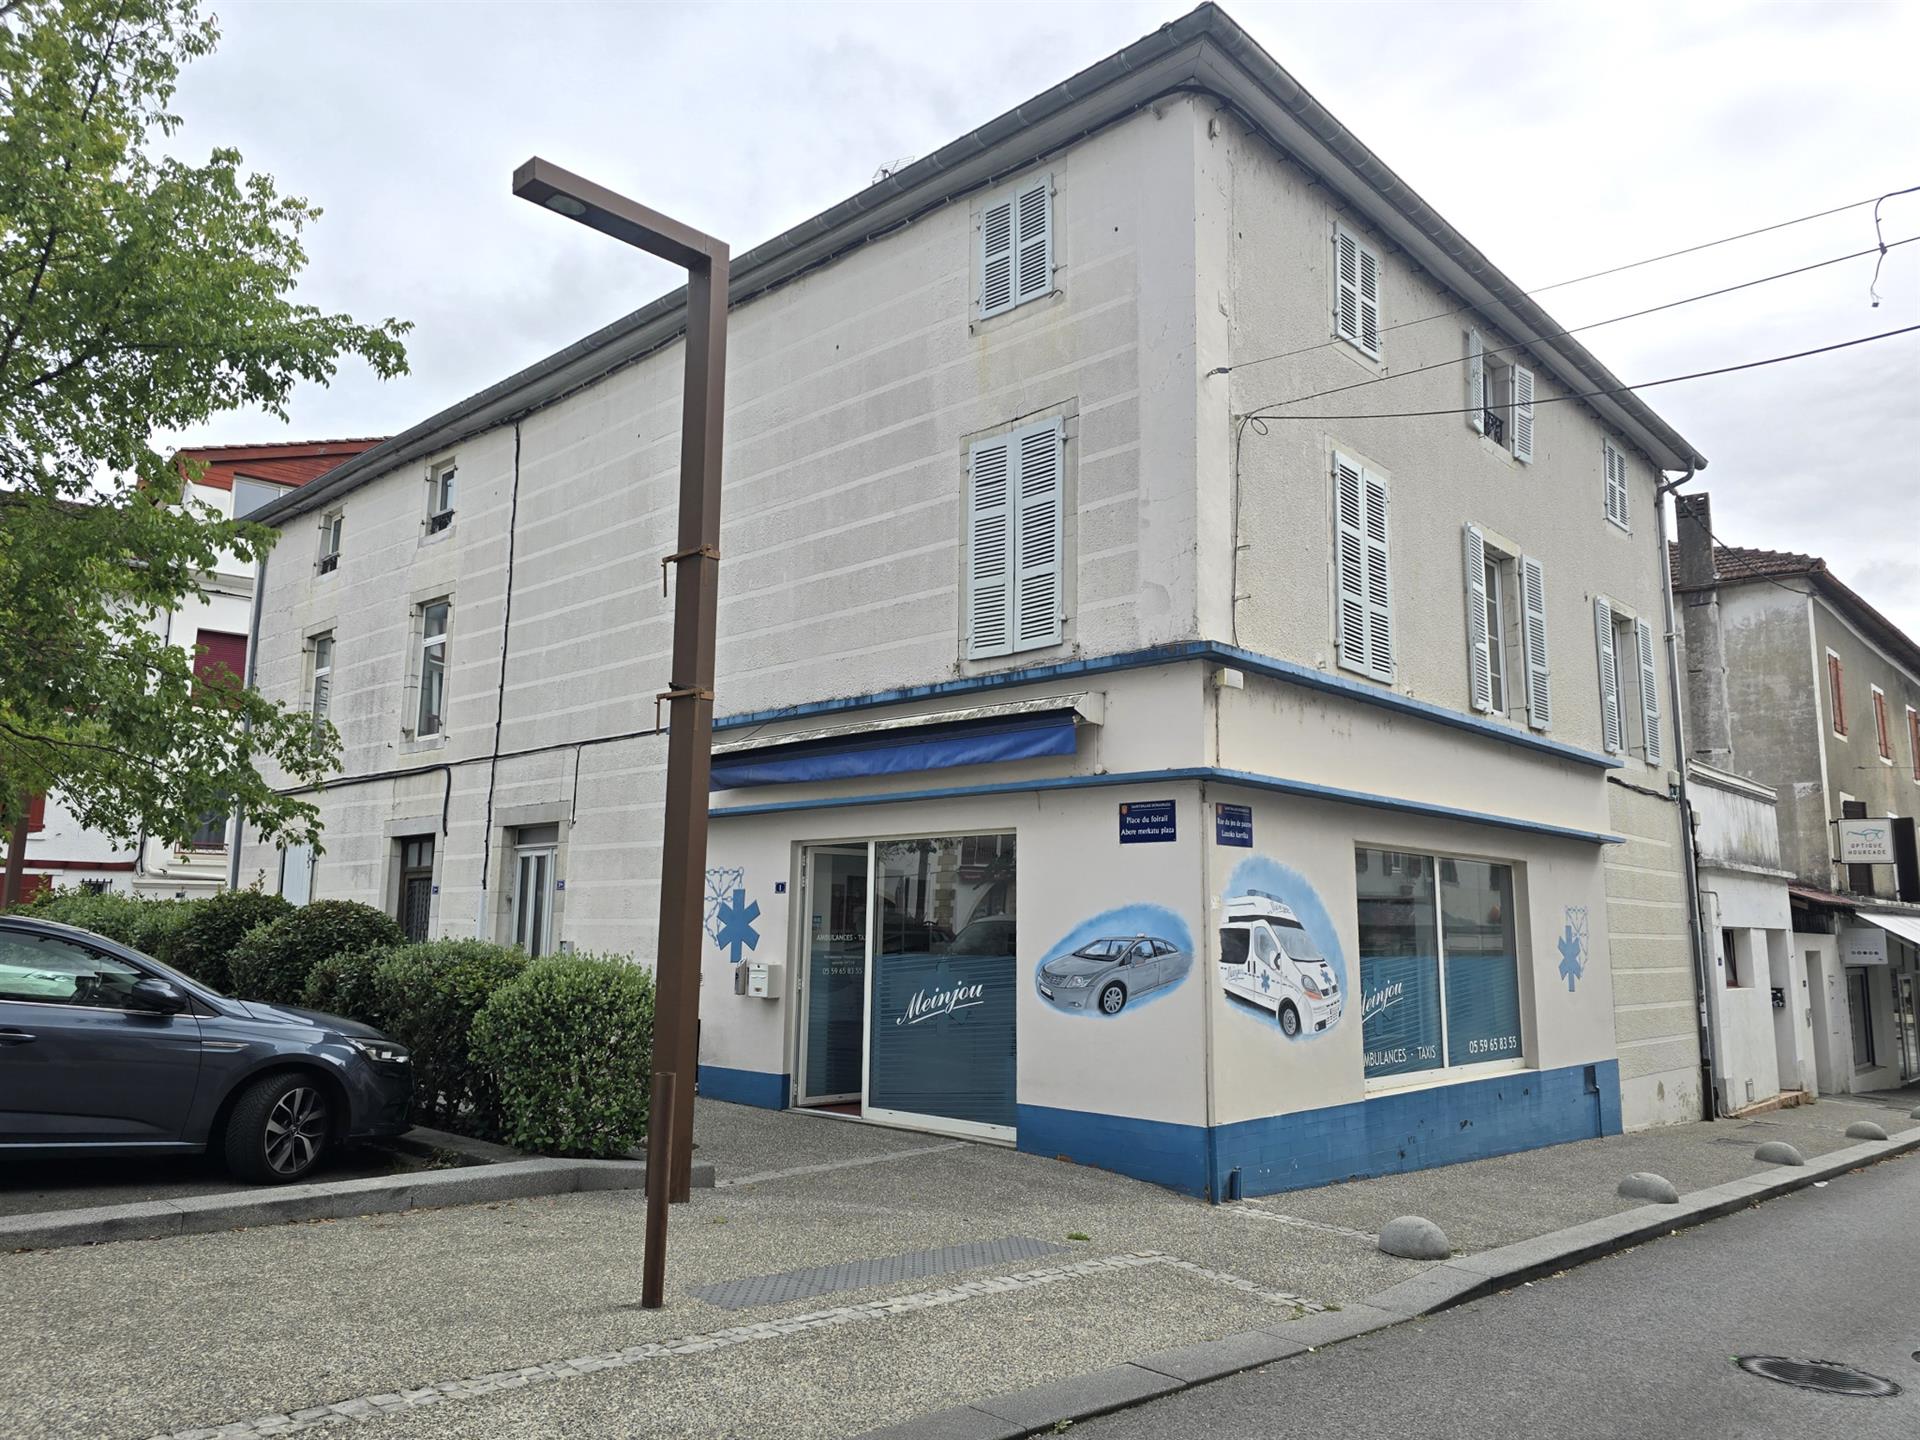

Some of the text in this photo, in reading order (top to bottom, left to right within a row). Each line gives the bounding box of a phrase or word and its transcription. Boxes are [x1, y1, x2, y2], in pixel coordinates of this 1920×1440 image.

[1142, 815, 1149, 823] du
[822, 967, 830, 975] 05
[831, 967, 839, 975] 59
[839, 967, 847, 975] 65
[896, 980, 984, 1025] Meinjou
[1469, 1035, 1517, 1054] 05 59 65 83 55
[1363, 1045, 1436, 1067] MBULANCES TAXIS
